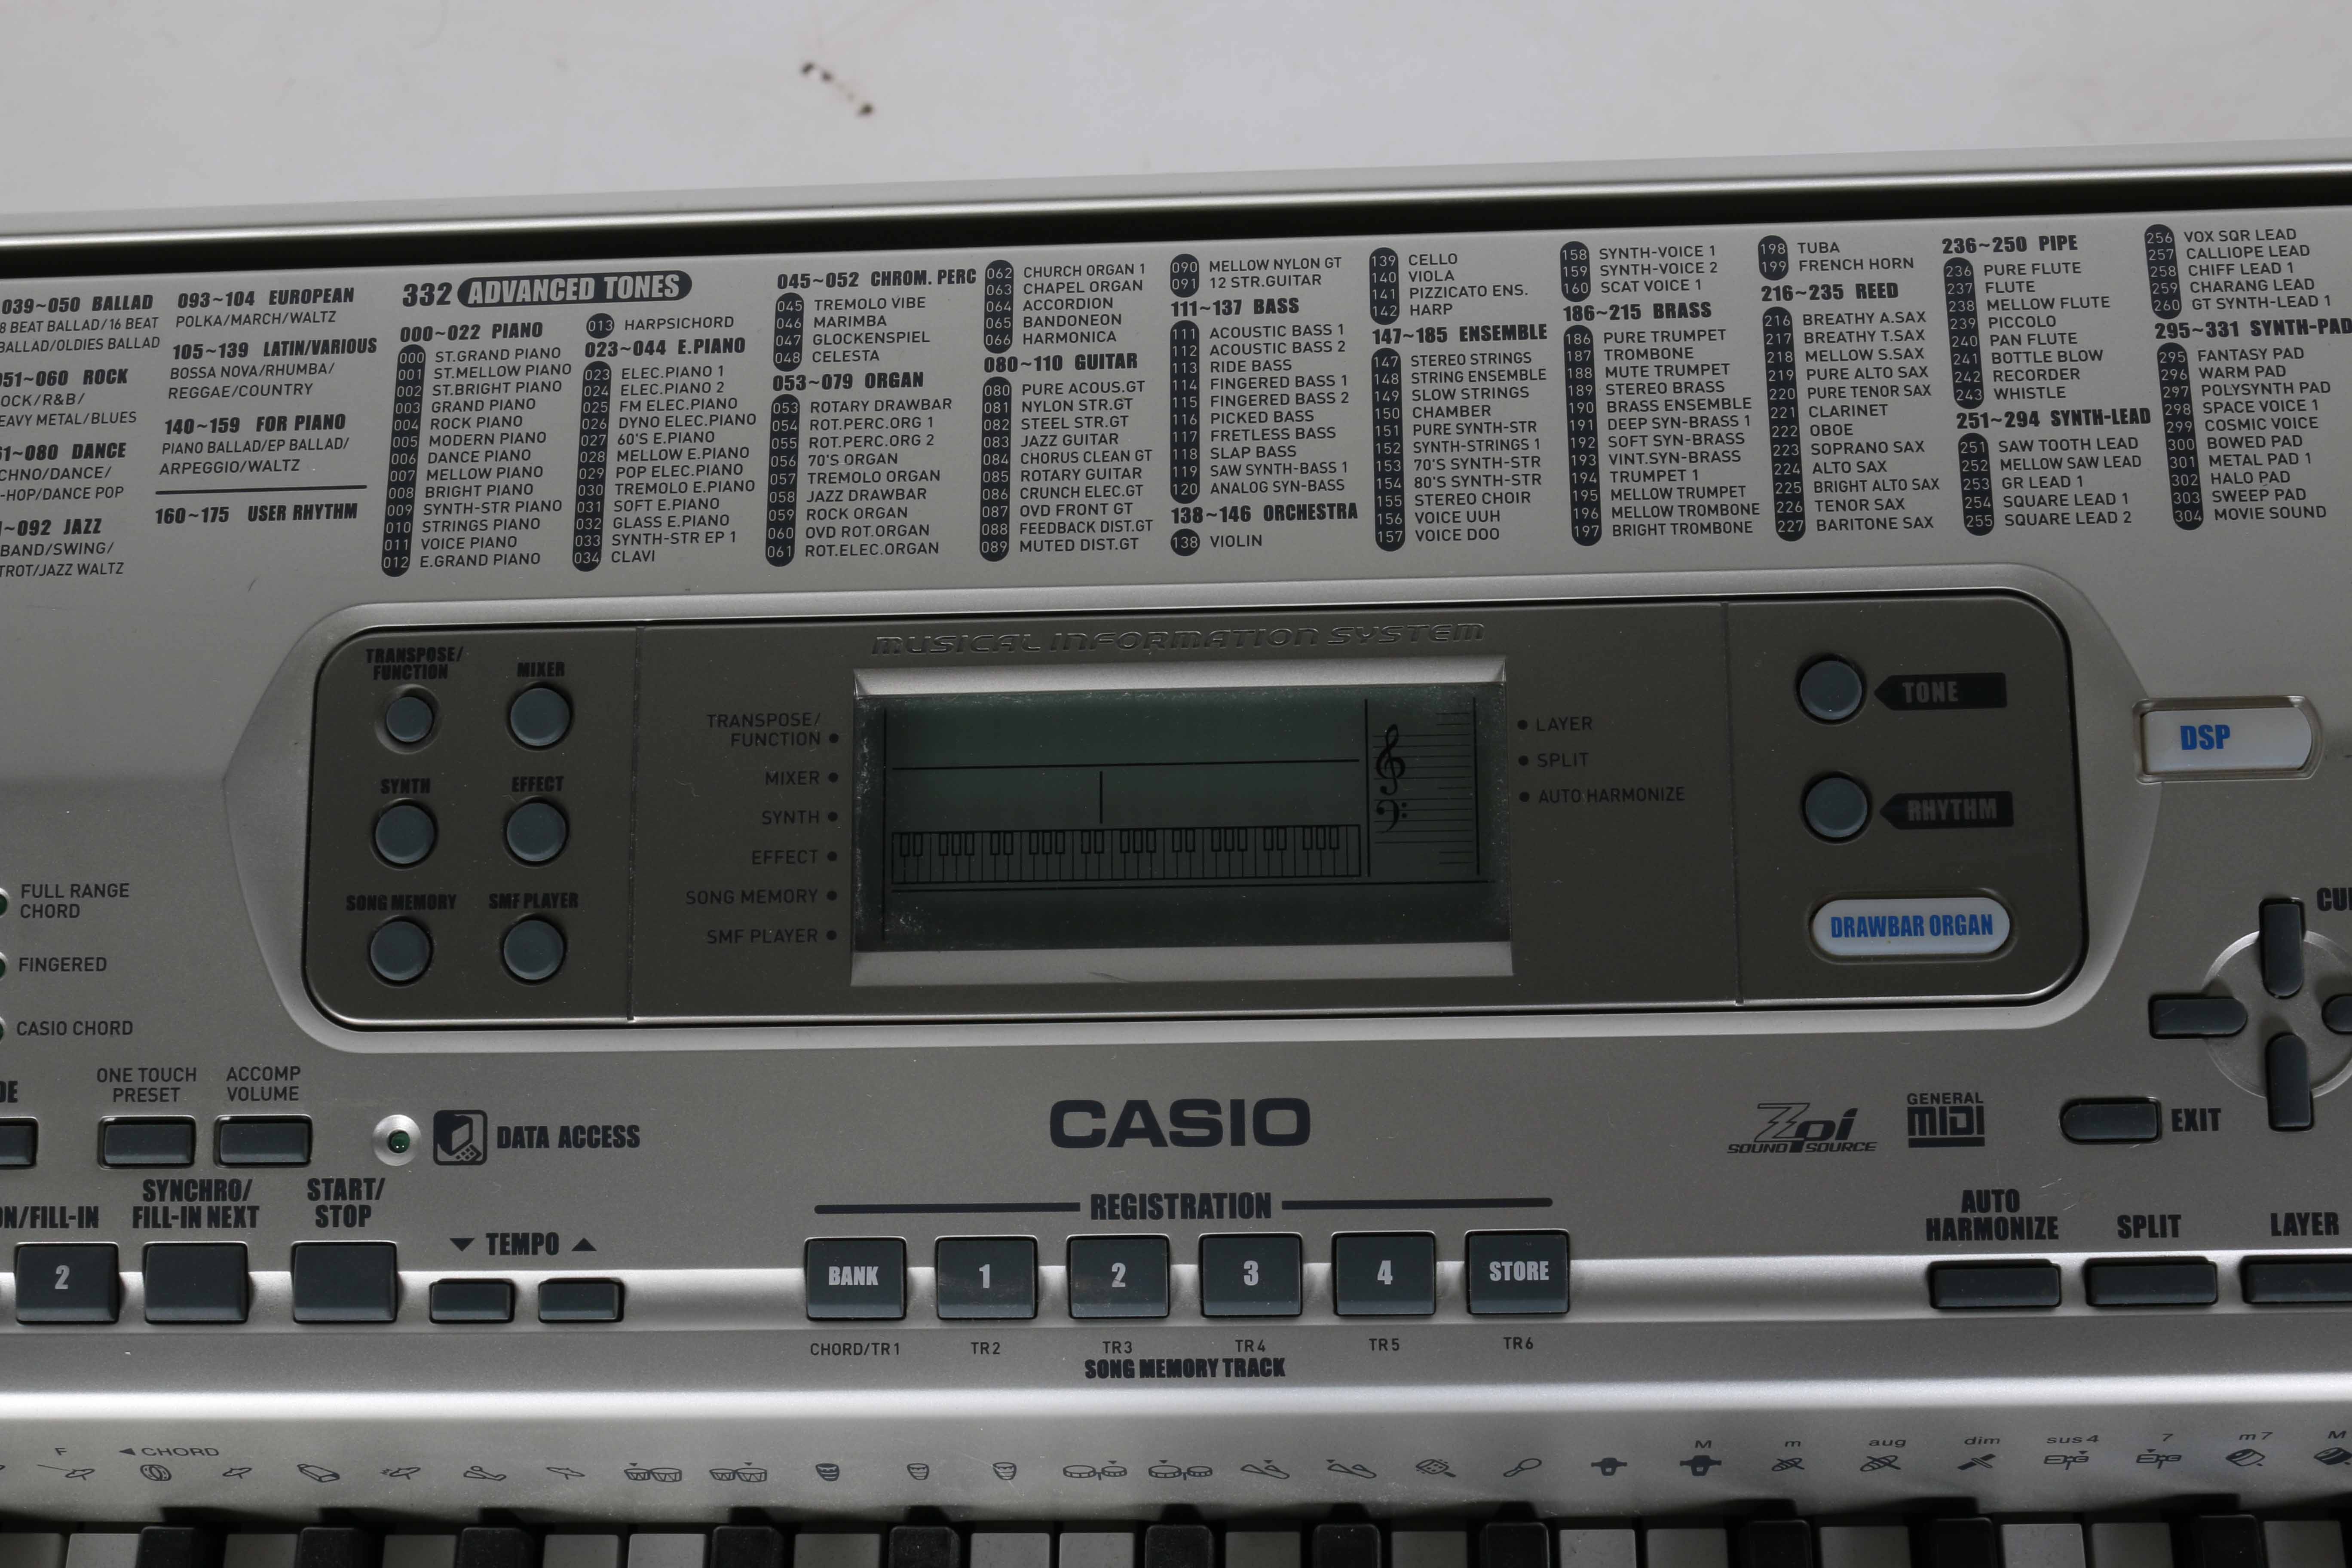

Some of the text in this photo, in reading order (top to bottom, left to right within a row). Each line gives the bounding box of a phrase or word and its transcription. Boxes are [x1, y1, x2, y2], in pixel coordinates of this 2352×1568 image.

[1942, 235, 2077, 254] 236~250 PIPE
[1409, 253, 1457, 266] CELLO
[1799, 257, 1913, 271] FRENCH HORN
[778, 269, 976, 289] 045~052 CHROM. PERC
[178, 288, 354, 308] 093~104 EUROPEAN
[403, 274, 679, 306] 332 ADVANCED TONES
[1761, 283, 1898, 301] 216~235 REED
[2, 295, 153, 314] 039~050 BALLAD
[1023, 297, 1112, 311] ACCORDION
[1171, 298, 1299, 316] 111~137 BASS
[1563, 302, 1711, 321] 186~215 BRASS
[2154, 295, 2330, 311] 260 GT SYNTH-LEAD 1
[176, 311, 336, 328] POLKA/MARCH/WALTZ
[588, 316, 734, 331] 013 HARPSICHORD
[2155, 318, 2352, 339] 295~331 SYNTH-PAD
[401, 322, 542, 342] 000~022 PIANO
[813, 331, 930, 345] GLOCKENSPIEL
[1372, 324, 1547, 344] 147~185 ENSEMBLE
[173, 338, 377, 359] 105~139 LATIN/VARIOUS
[585, 337, 745, 358] 023~044 E.PIANO
[1604, 347, 1694, 361] TROMBONE
[984, 353, 1137, 373] 080~110 GUITAR
[773, 372, 923, 391] 053~079 ORGAN
[1994, 368, 2080, 382] RECORDER
[1809, 404, 1888, 417] CLARINET
[1957, 408, 2150, 429] 251~294 SYNTH-LEAD
[165, 414, 345, 434] 140~159 FOR PIANO
[156, 503, 357, 524] 160~175 USER RHYTHM
[1171, 503, 1357, 524] 138~146 ORCHESTRA
[2214, 506, 2326, 520] MOVIE SOUND
[1210, 535, 1262, 547] VIOLIN
[366, 646, 463, 663] TRANSPOSE/
[374, 664, 447, 680] FUNCTION
[518, 662, 564, 677] MIXER
[1902, 681, 1958, 703] TONE
[707, 713, 820, 728] TRANSPOSE/
[1537, 717, 1592, 731] LAYER
[732, 732, 820, 747] FUNCTION
[2180, 725, 2230, 750] DSP
[1537, 753, 1589, 767] SPLIT
[381, 778, 430, 794] SYNTH
[512, 776, 564, 792] EFFECT
[766, 771, 819, 785] MIXER
[1539, 787, 1685, 803] AUTO HARMONIZE
[762, 810, 819, 824] SYNTH
[1908, 799, 1997, 821] RHYTHM
[752, 850, 818, 864] EFFECT
[21, 883, 129, 898] FULL RANGE
[686, 889, 818, 904] SONG MEMORY
[346, 894, 456, 911] SONG MEMORY
[489, 893, 578, 909] SMF PLAYER
[21, 904, 80, 918] CHORD
[1831, 914, 1993, 937] DRAWBAR ORGAN
[708, 928, 818, 943] SMF PLAYER
[19, 957, 107, 971] FINGERED
[17, 1021, 132, 1035] CASIO CHORD
[97, 1067, 196, 1082] ONE TOUCH
[226, 1066, 300, 1081] ACCOMP
[113, 1087, 180, 1102] PRESET
[227, 1086, 299, 1101] VOLUME
[1907, 1092, 1983, 1105] GENERAL
[1050, 1098, 1311, 1148] CASIO
[1908, 1106, 1984, 1136] MIDI
[2171, 1108, 2221, 1132] EXIT
[497, 1125, 640, 1148] DATA ACCESS
[1727, 1142, 1877, 1153] SOUND SOURCE
[143, 1179, 252, 1202] SYNCHRO/
[308, 1178, 385, 1201] START/
[1091, 1192, 1271, 1220] REGISTRATION
[1962, 1189, 2020, 1213] AUTO
[133, 1206, 259, 1228] FILL-IN NEXT
[315, 1204, 371, 1228] STOP
[2271, 1212, 2339, 1236] LAYER
[1926, 1216, 2058, 1241] HARMONIZE
[2117, 1215, 2181, 1239] SPLIT
[486, 1232, 559, 1255] TEMPO
[55, 1265, 69, 1289] 2
[829, 1267, 878, 1285] BANK
[979, 1264, 989, 1288] 1
[1112, 1263, 1125, 1287] 2
[1244, 1261, 1258, 1286] 3
[1378, 1261, 1393, 1284] 4
[1490, 1261, 1549, 1281] STORE
[1085, 1357, 1285, 1378] SONG MEMORY TRACK
[1964, 1436, 2000, 1445] dim
[2163, 1433, 2173, 1442] 7
